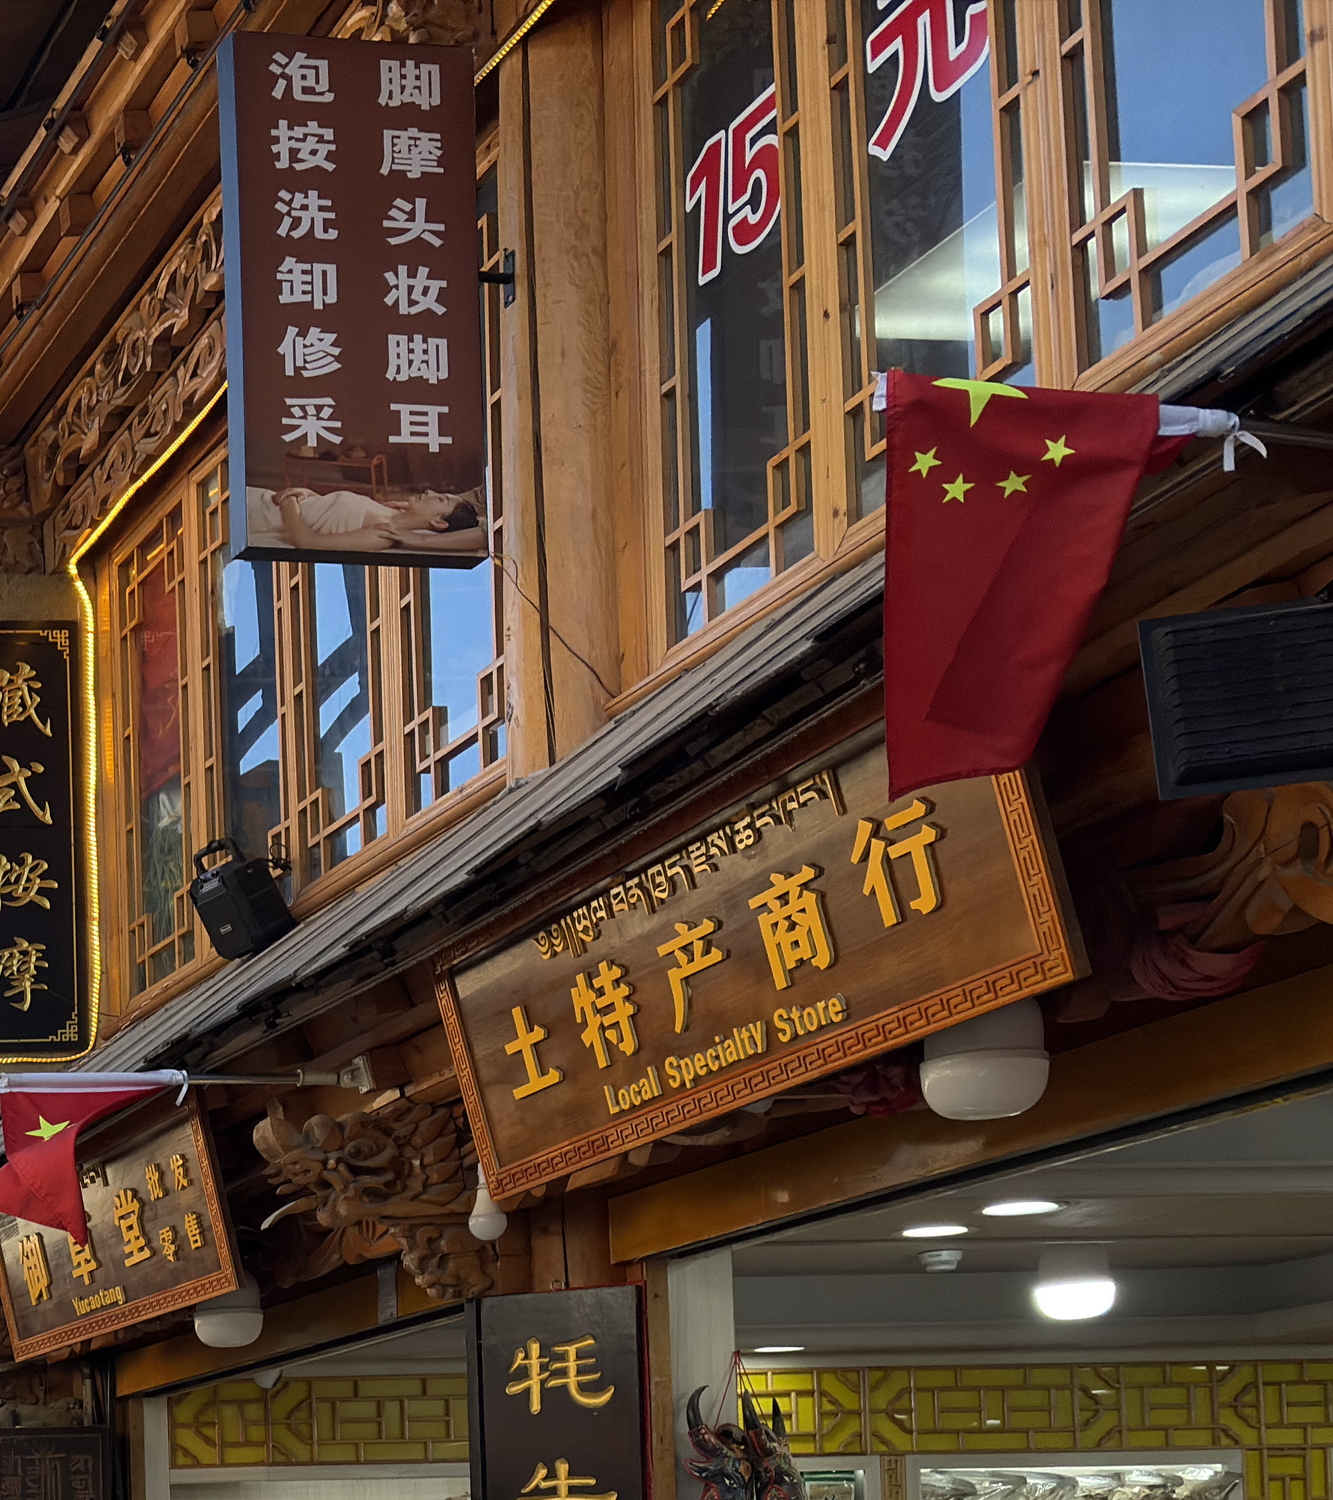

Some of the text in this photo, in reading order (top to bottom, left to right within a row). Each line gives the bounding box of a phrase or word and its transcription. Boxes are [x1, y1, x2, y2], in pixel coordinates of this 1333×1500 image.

[685, 83, 781, 285] 15
[504, 798, 941, 1101] 土特产商行
[603, 992, 847, 1114] Local Specialty Store
[145, 1154, 190, 1201] 批发
[159, 1212, 203, 1263] 零售
[71, 1286, 125, 1317] Yucaotang
